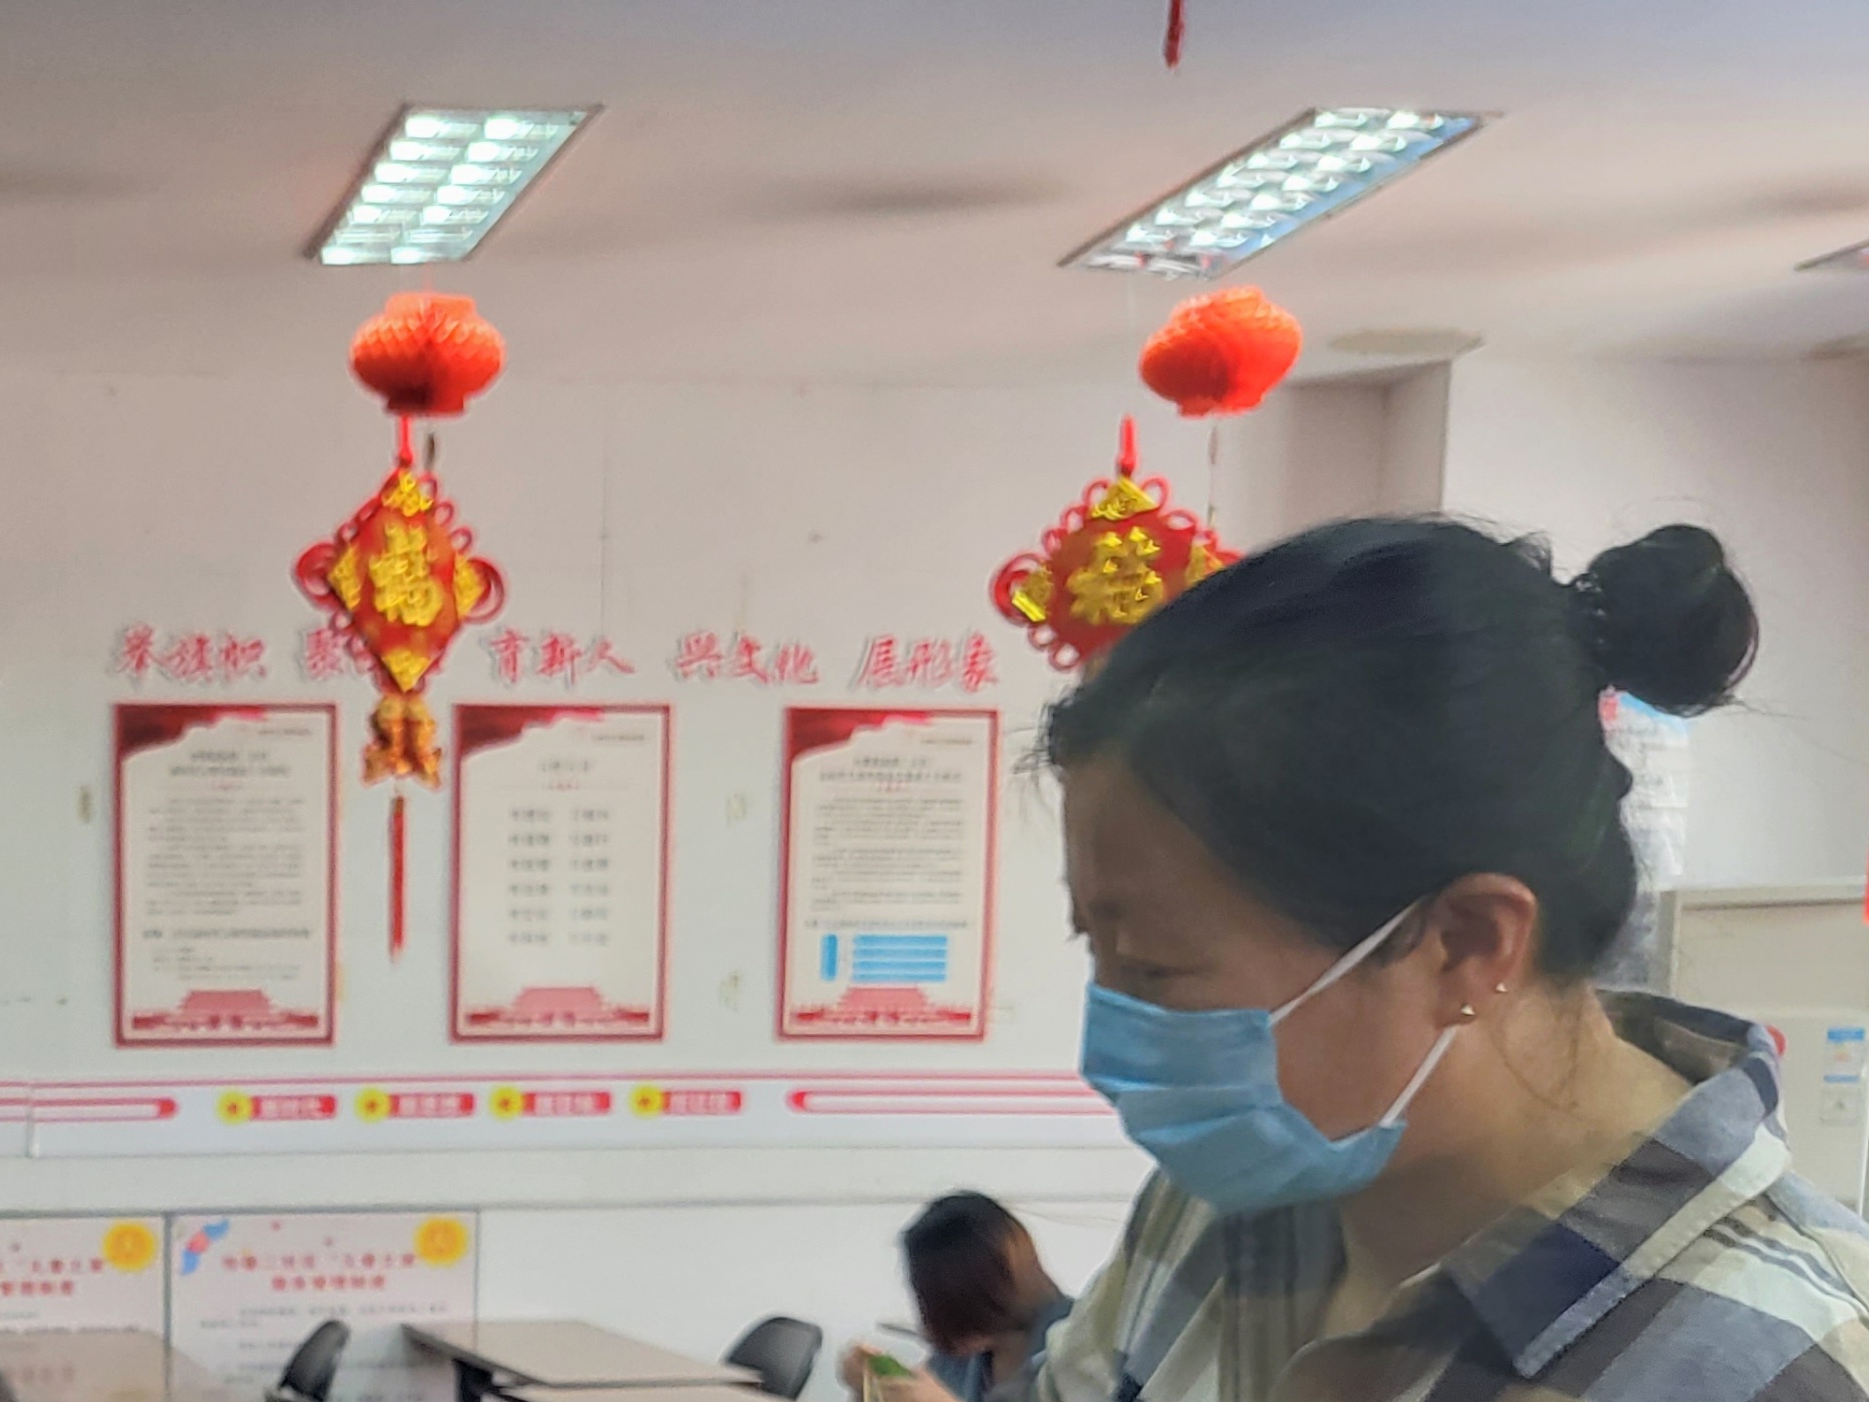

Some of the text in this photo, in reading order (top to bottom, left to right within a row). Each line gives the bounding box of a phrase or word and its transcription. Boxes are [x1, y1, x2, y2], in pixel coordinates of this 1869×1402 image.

[485, 630, 635, 690] 育新人
[673, 630, 821, 685] 兴文化
[852, 630, 1003, 695] 展形象
